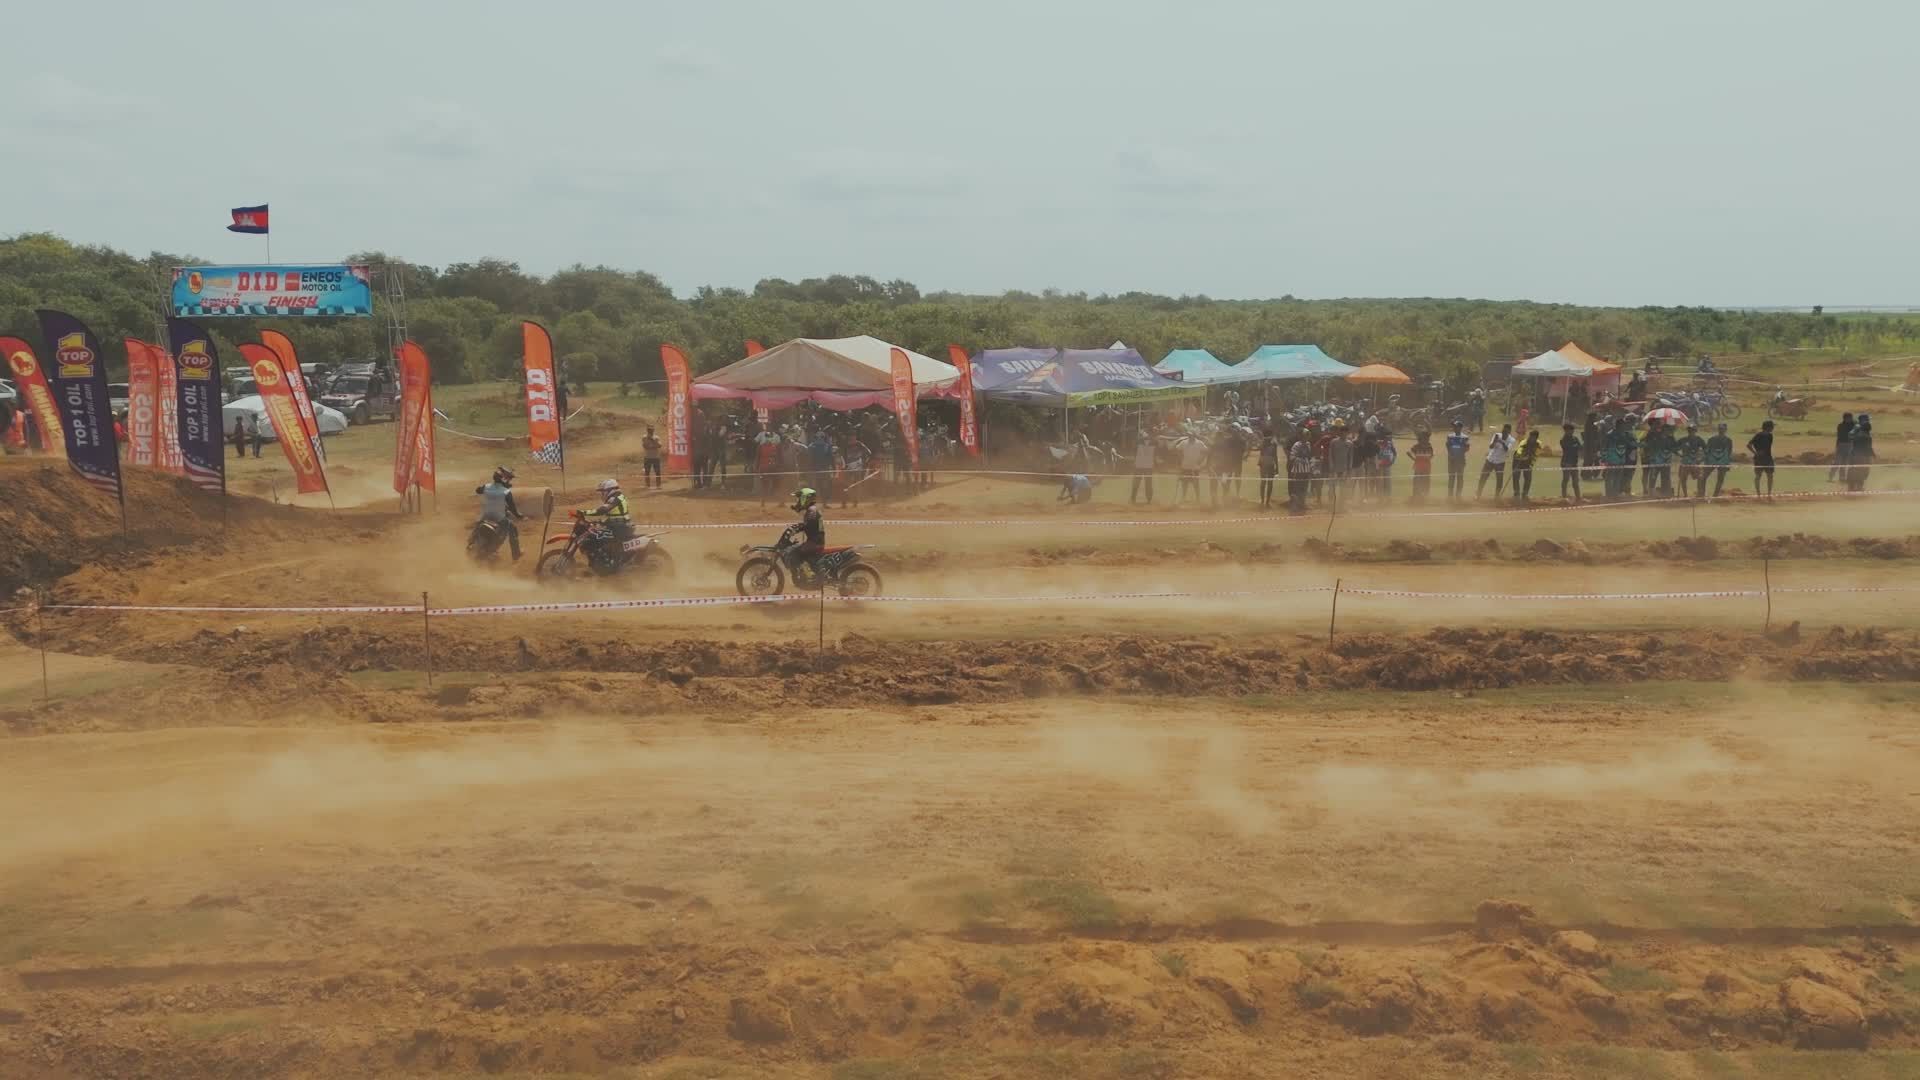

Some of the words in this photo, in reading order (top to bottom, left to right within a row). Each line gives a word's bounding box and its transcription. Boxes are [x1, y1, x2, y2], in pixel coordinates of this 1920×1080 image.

[302, 272, 341, 283] ENEOS
[268, 296, 317, 307] FINISH
[61, 351, 89, 361] TOP
[184, 356, 207, 365] TOP
[67, 384, 82, 405] OIL
[184, 384, 198, 405] OIL
[71, 408, 83, 416] 1
[73, 418, 89, 447] TOP
[186, 417, 200, 441] TOP
